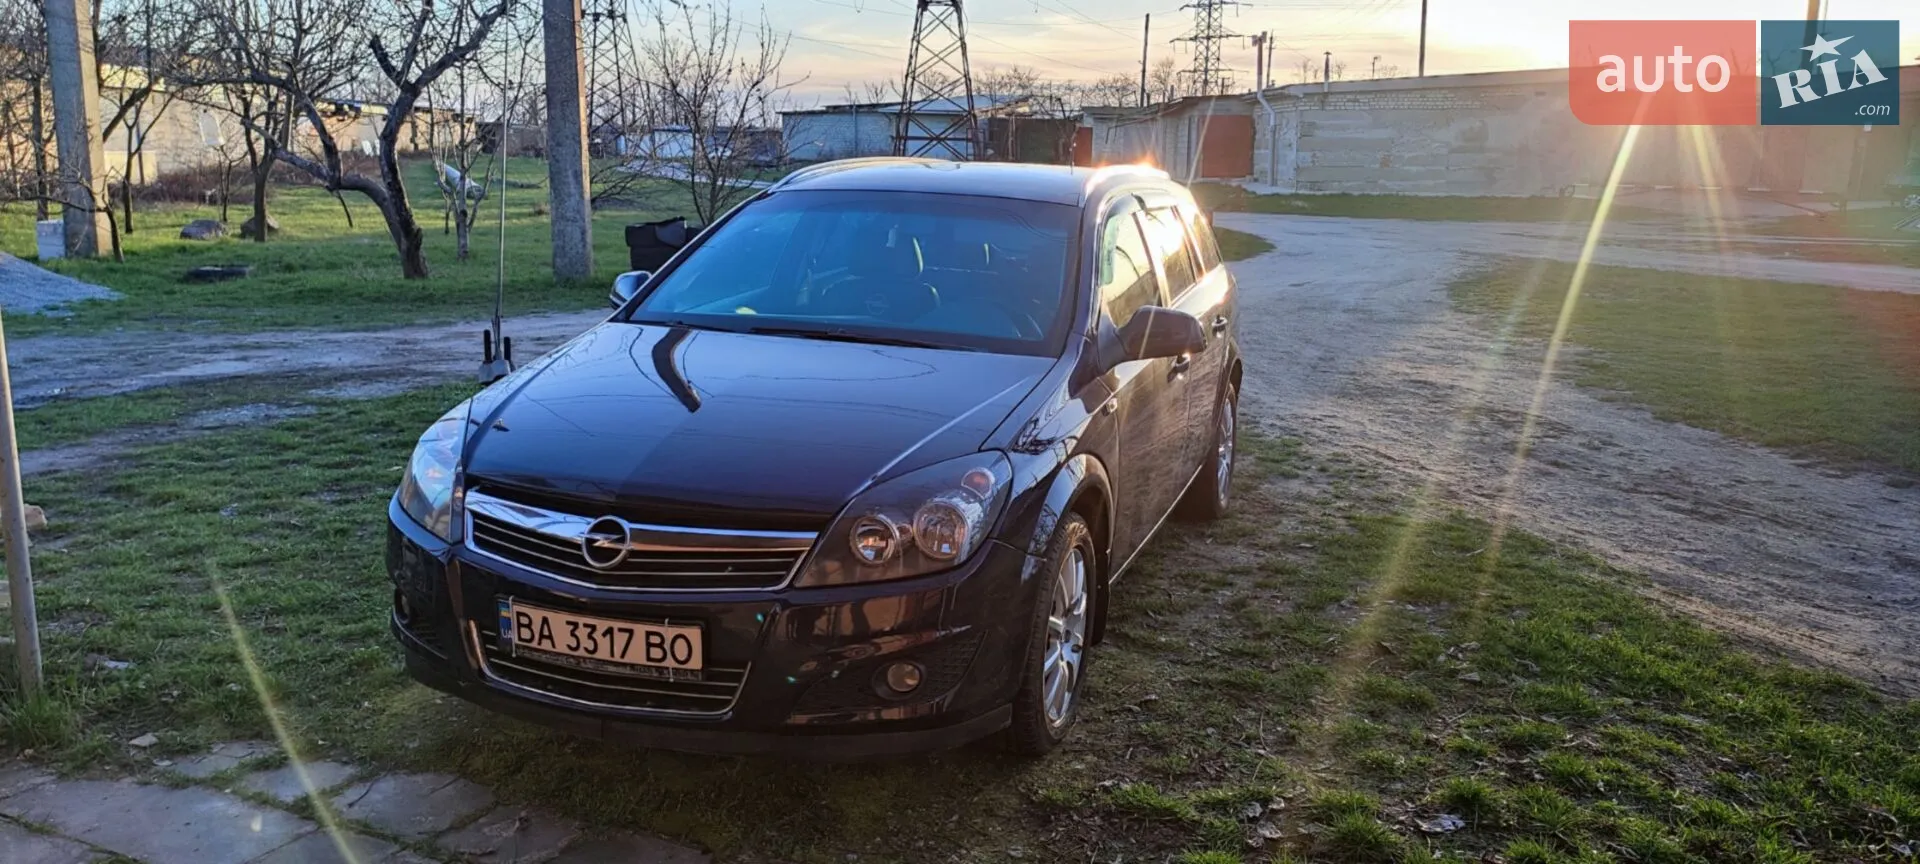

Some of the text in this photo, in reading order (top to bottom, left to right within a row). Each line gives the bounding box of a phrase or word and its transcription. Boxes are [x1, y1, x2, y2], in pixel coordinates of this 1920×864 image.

[516, 611, 556, 649] BA
[565, 621, 634, 659] 3317
[645, 630, 693, 665] BO
